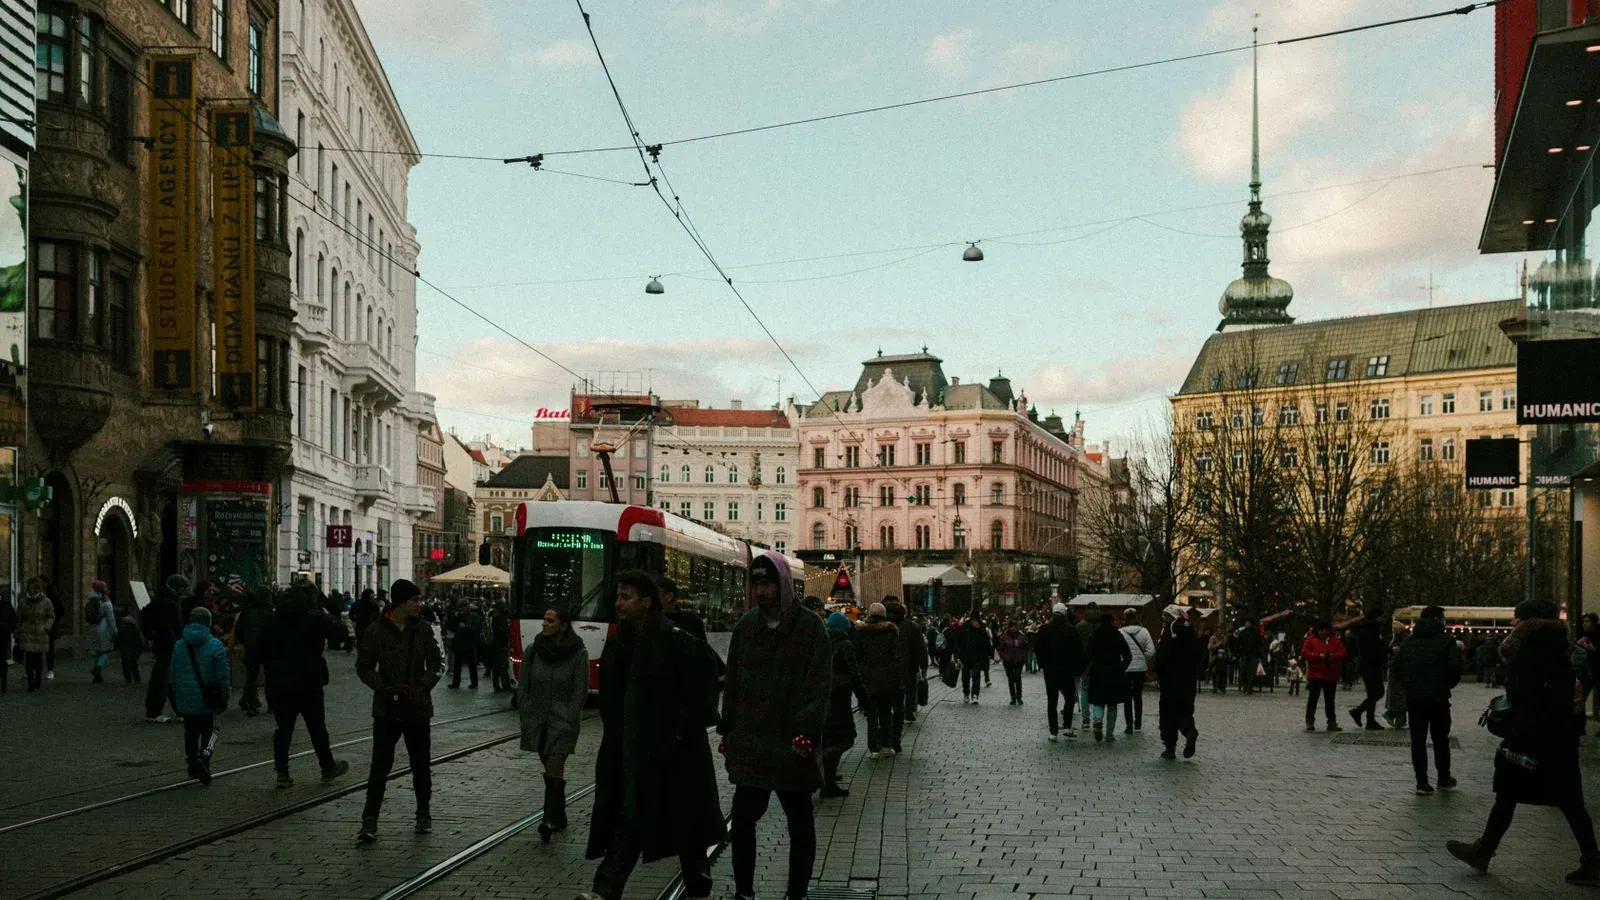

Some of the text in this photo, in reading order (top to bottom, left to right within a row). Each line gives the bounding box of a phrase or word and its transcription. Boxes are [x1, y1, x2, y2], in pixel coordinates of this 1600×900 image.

[158, 118, 176, 329] STUDENT AGENCY
[1523, 402, 1600, 418] HUMANIC
[1469, 476, 1517, 486] HUMANIC
[333, 528, 347, 544] T
